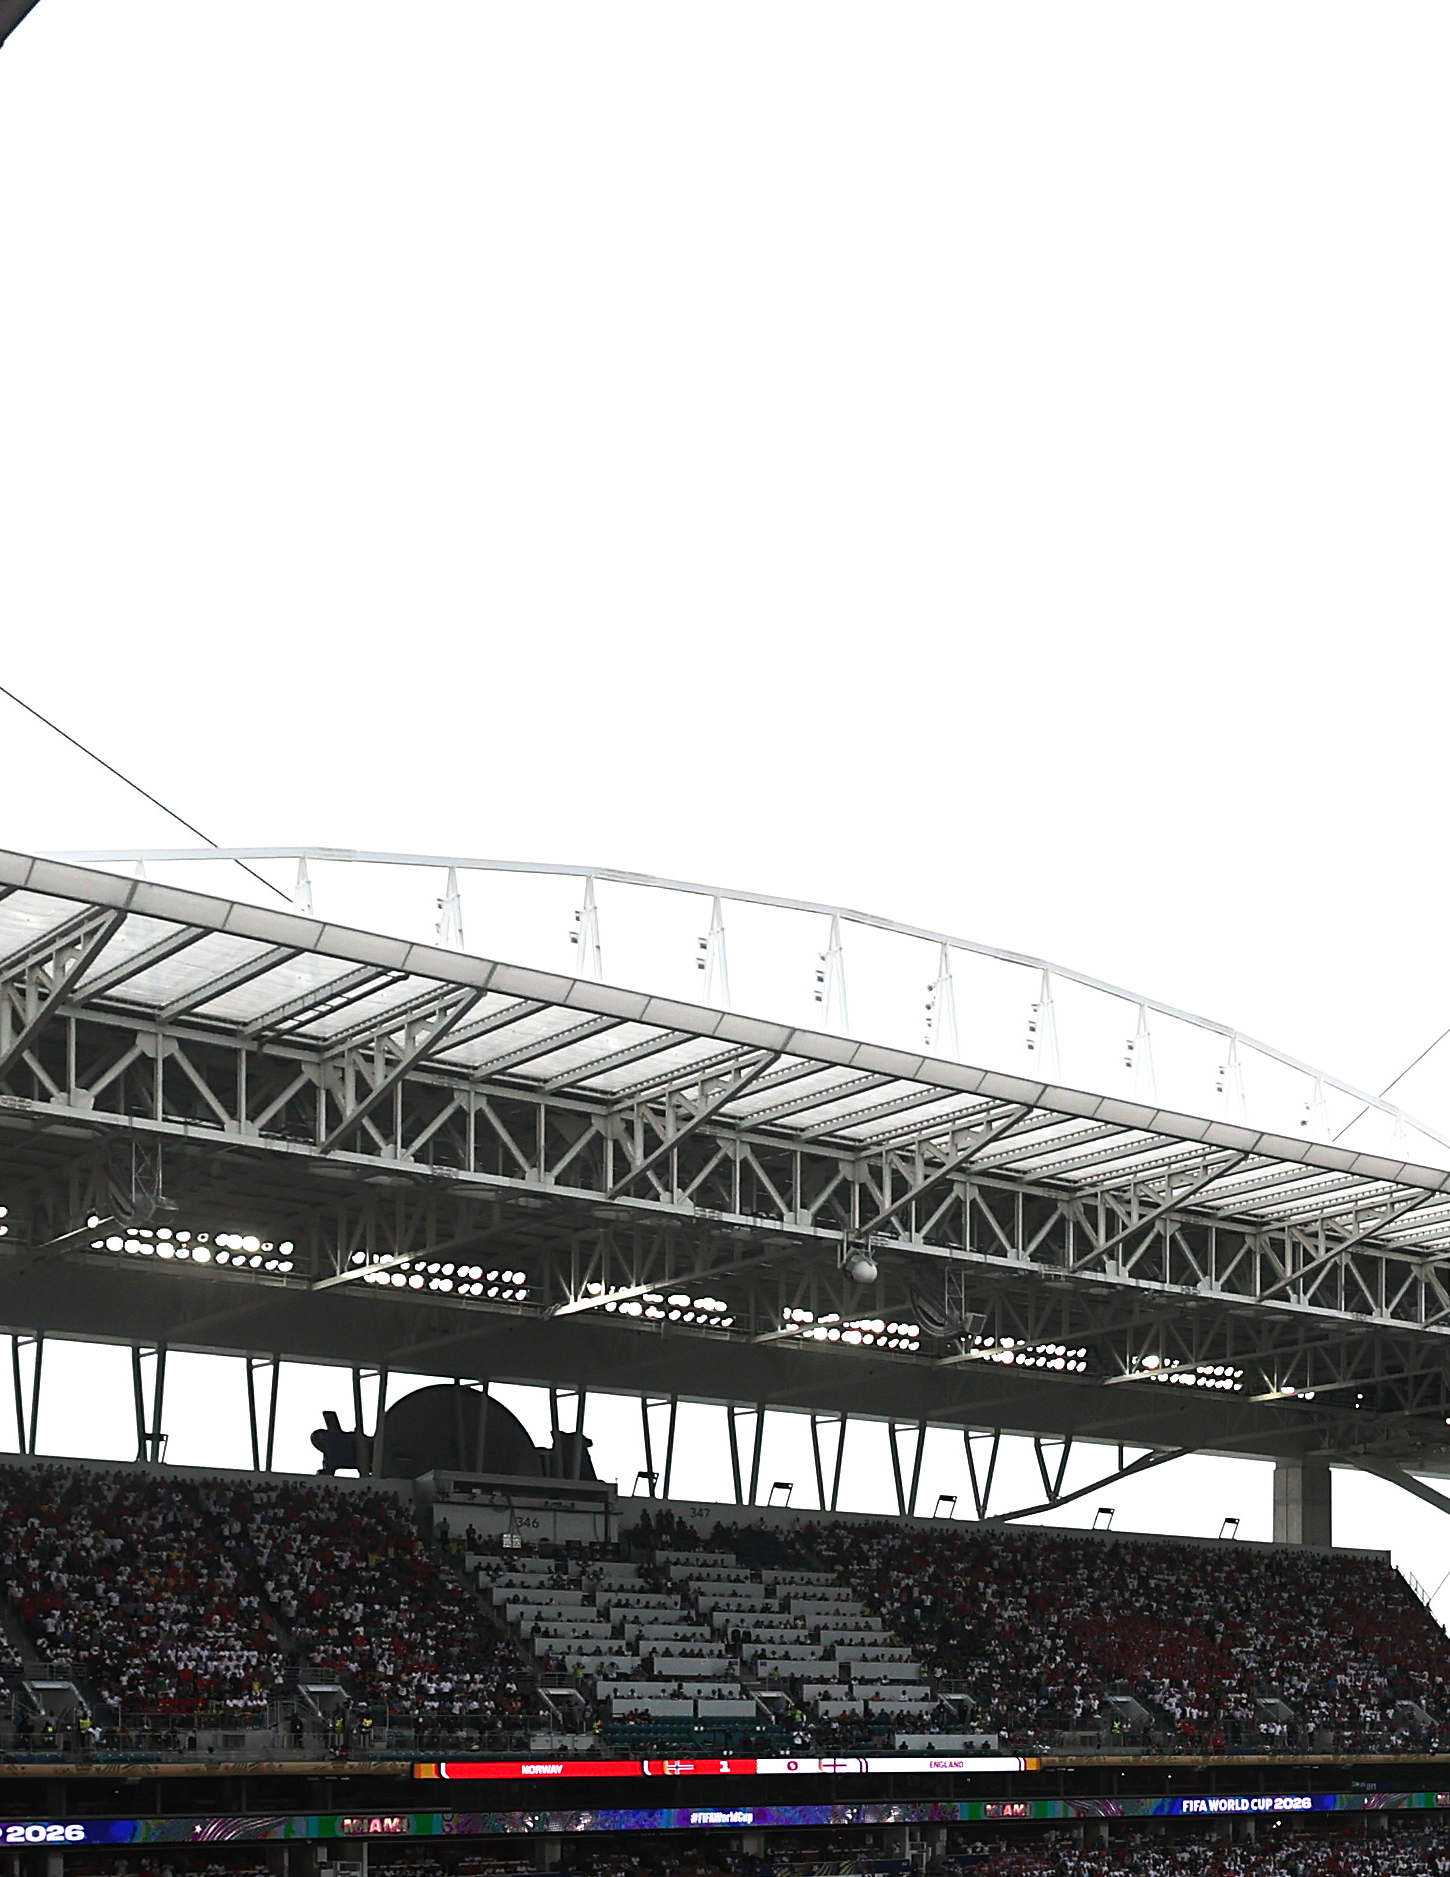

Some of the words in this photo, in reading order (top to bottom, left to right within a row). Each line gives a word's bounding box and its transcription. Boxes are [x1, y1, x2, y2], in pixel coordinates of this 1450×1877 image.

[522, 1765, 563, 1774] NORWAY
[720, 1761, 730, 1772] 1
[929, 1760, 964, 1769] ENGLAND
[1183, 1800, 1207, 1812] FIFA
[1209, 1799, 1249, 1811] WORLD
[1251, 1798, 1273, 1810] CUP
[1274, 1797, 1311, 1809] 2026
[691, 1812, 753, 1824] #FIFAWorldCup
[343, 1816, 408, 1833] MIAMI
[7, 1825, 84, 1842] 2026
